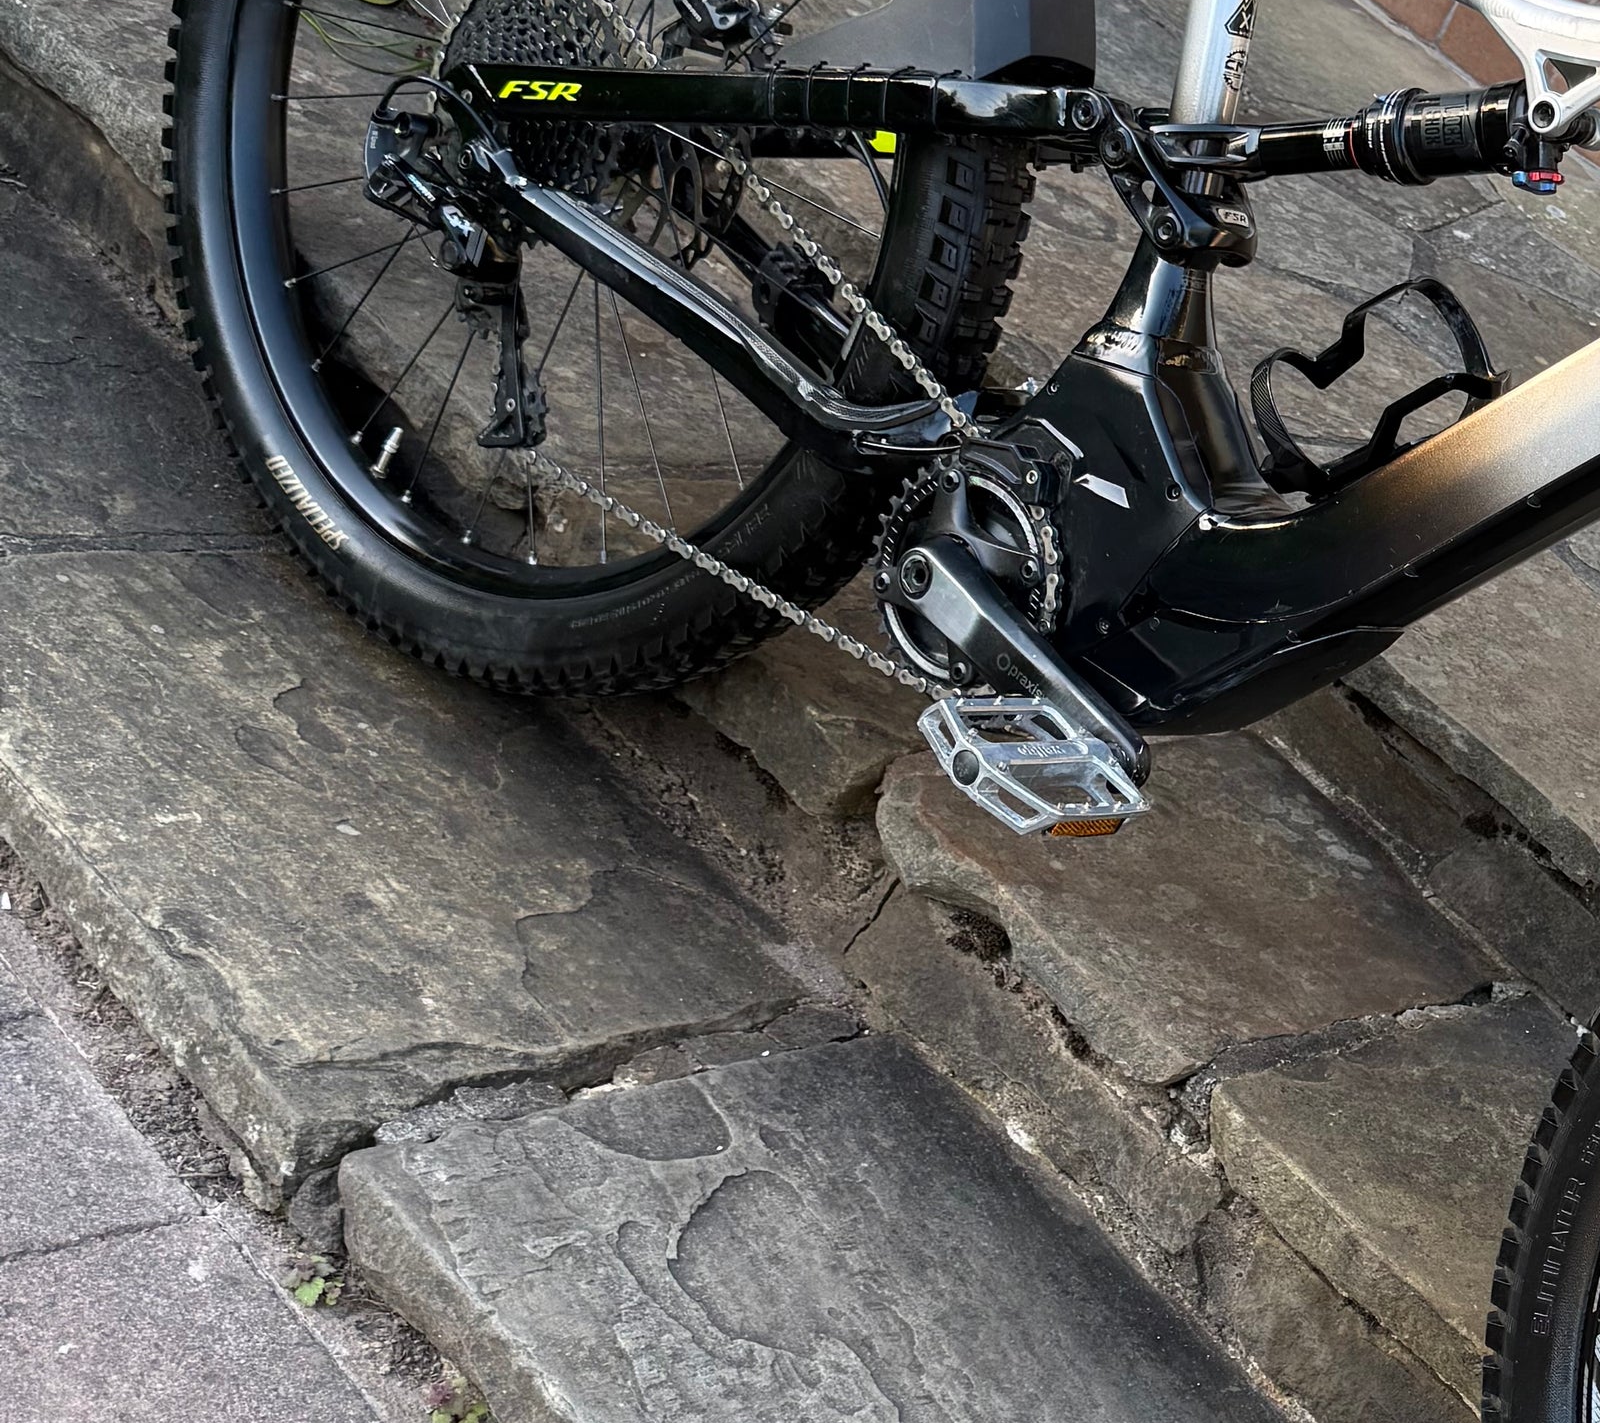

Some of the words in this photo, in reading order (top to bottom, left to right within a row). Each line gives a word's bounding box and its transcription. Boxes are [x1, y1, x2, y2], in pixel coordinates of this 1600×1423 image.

[498, 79, 583, 103] FSR
[1224, 211, 1247, 224] FSR
[266, 454, 347, 550] SPECIALIZED
[1531, 1177, 1586, 1337] ELIMINATOR
